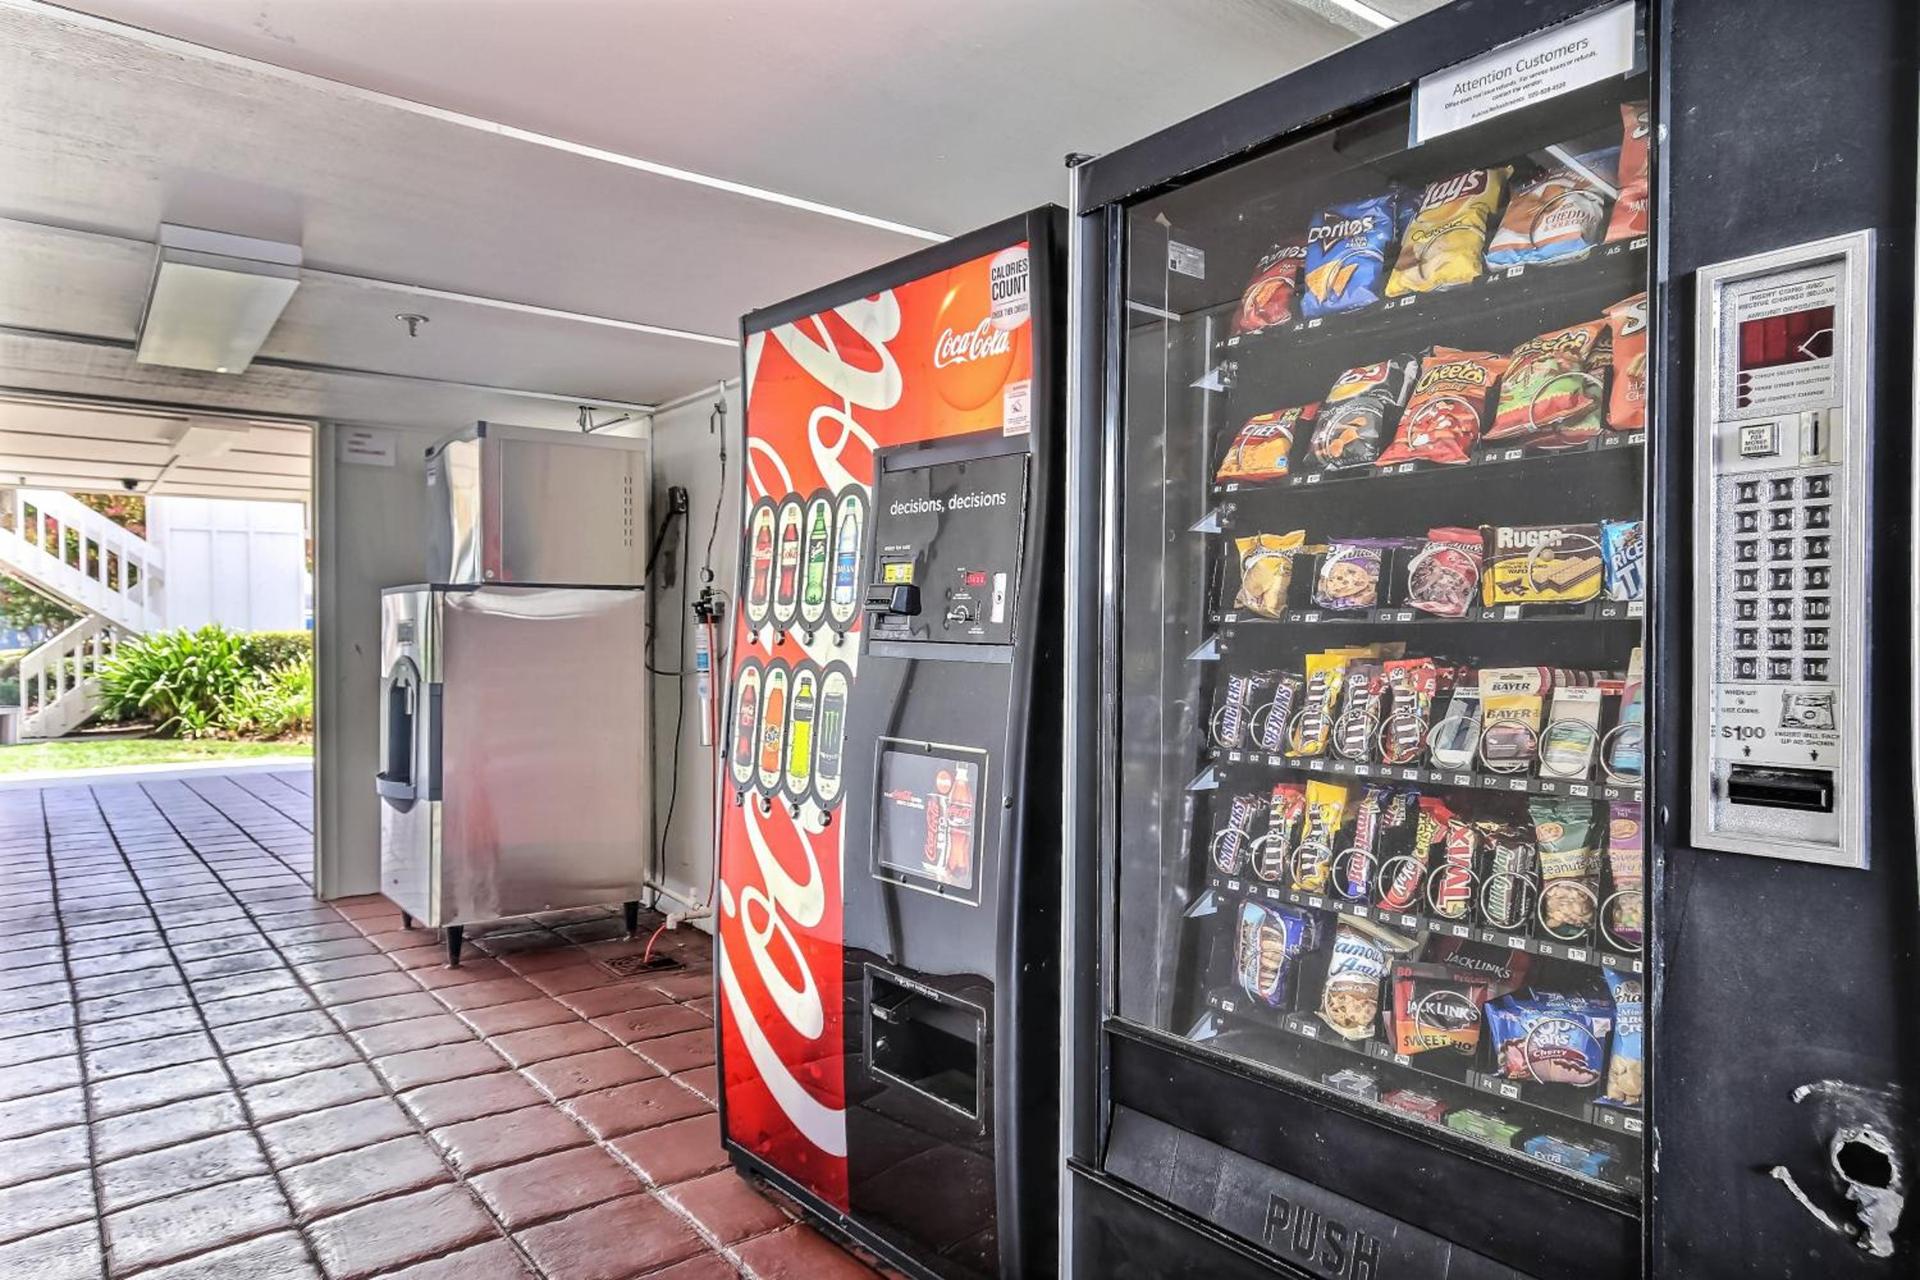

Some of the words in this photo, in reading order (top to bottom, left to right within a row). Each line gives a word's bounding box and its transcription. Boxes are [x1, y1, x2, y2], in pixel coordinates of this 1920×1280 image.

[1453, 67, 1512, 96] Attention
[1516, 38, 1588, 72] Customers
[1308, 216, 1374, 244] Doritos
[992, 258, 1028, 280] CALORIES
[992, 274, 1028, 301] COUNT
[934, 317, 1010, 369] Coca-Cola
[1416, 361, 1485, 393] Cheetos
[1744, 487, 1752, 498] A
[1814, 481, 1822, 493] 2
[890, 498, 945, 516] decisions,
[948, 491, 1007, 511] decisions
[1778, 514, 1786, 525] 3
[1814, 512, 1823, 523] 4
[1744, 545, 1752, 557] C
[1778, 544, 1787, 556] 5
[1814, 542, 1822, 554] 6
[1743, 574, 1752, 586] D
[1779, 574, 1787, 585] 7
[1814, 572, 1821, 584] 8
[1602, 609, 1616, 617] C5
[1744, 604, 1752, 616] E
[1778, 604, 1786, 616] 9
[1811, 602, 1825, 614] 10
[1482, 611, 1495, 619] C4
[1744, 634, 1752, 645] F
[1811, 633, 1825, 645] 12
[1743, 664, 1751, 674] G
[1774, 663, 1788, 674] 13
[1811, 663, 1824, 675] 14
[1492, 683, 1530, 691] BAYER
[1430, 773, 1442, 781] D6
[1542, 783, 1555, 791] D8
[1605, 788, 1618, 798] D9
[1483, 933, 1494, 942] E7
[1444, 952, 1475, 971] JACK
[1535, 1152, 1562, 1163] Extra
[1263, 1193, 1381, 1280] PUSH
